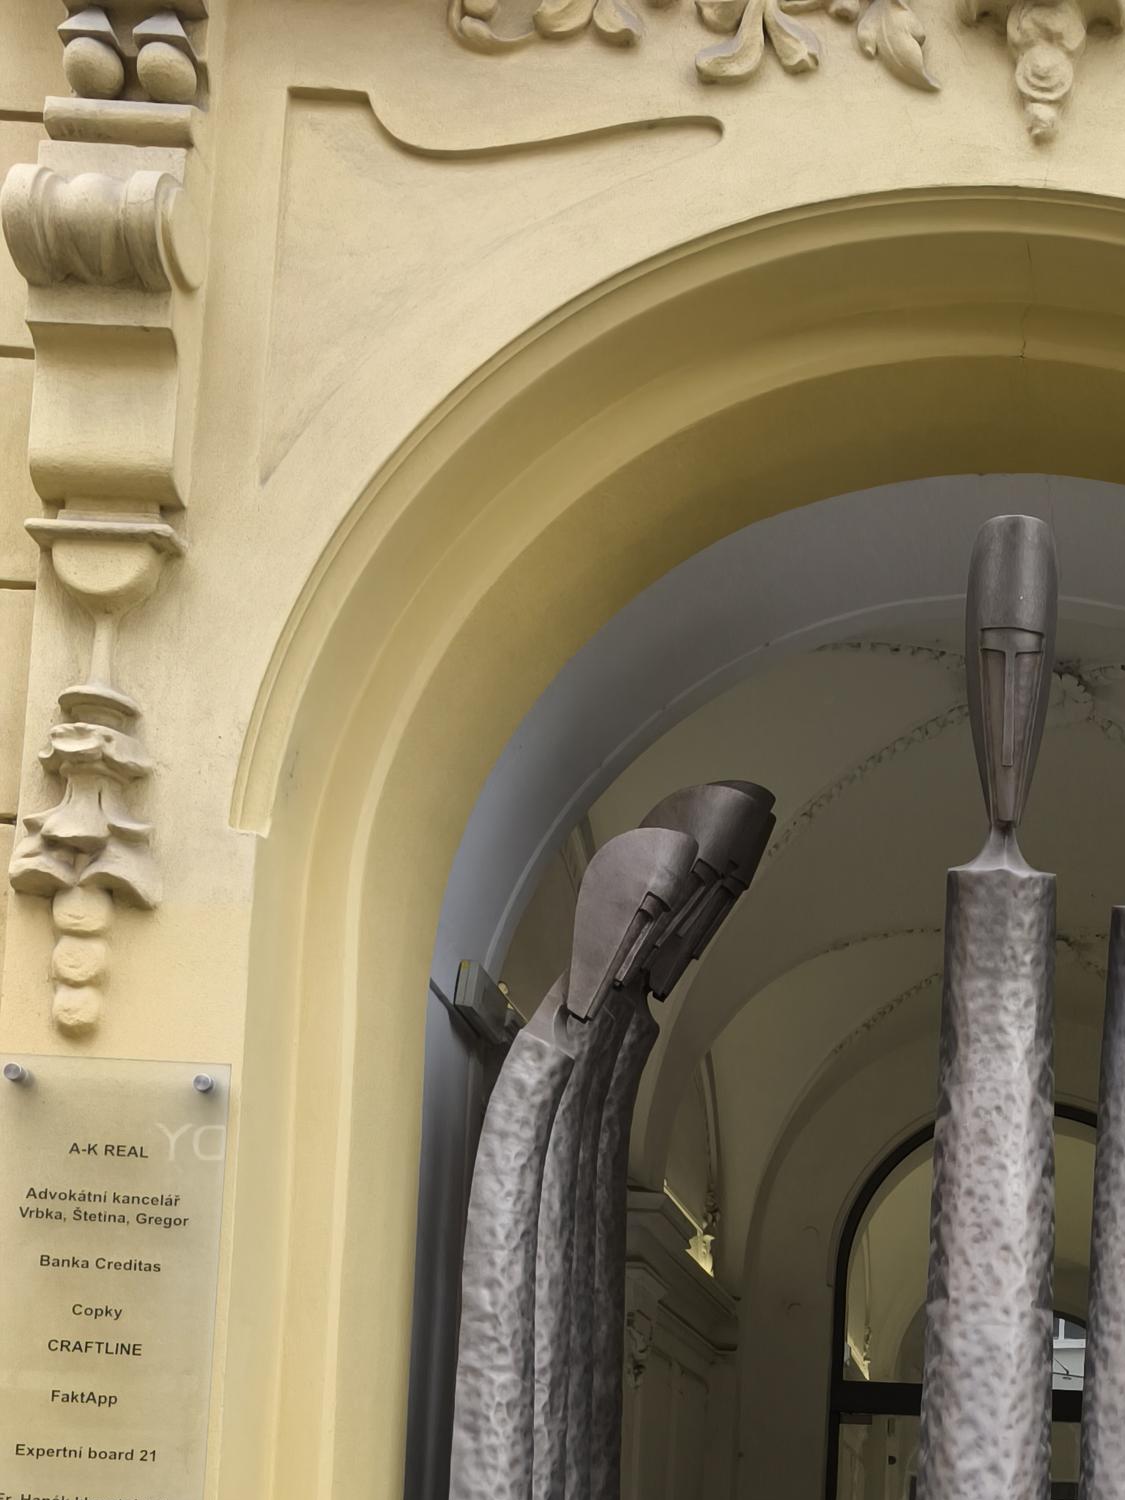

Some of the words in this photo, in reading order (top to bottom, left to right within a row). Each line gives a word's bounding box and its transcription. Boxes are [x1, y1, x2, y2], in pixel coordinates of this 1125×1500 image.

[69, 1143, 98, 1155] A-K
[104, 1144, 148, 1158] REAL
[26, 1187, 107, 1203] Advokátní
[113, 1192, 180, 1206] kancelář
[19, 1206, 66, 1222] Vrbka,
[136, 1213, 189, 1228] Gregor
[40, 1255, 89, 1268] Banka
[95, 1258, 160, 1272] Creditas
[72, 1304, 122, 1320] Copky
[48, 1339, 142, 1356] CRAFTLINE
[51, 1390, 117, 1407] FaktApp
[16, 1444, 82, 1459] Expertní
[88, 1447, 134, 1460] board
[140, 1450, 155, 1462] 21
